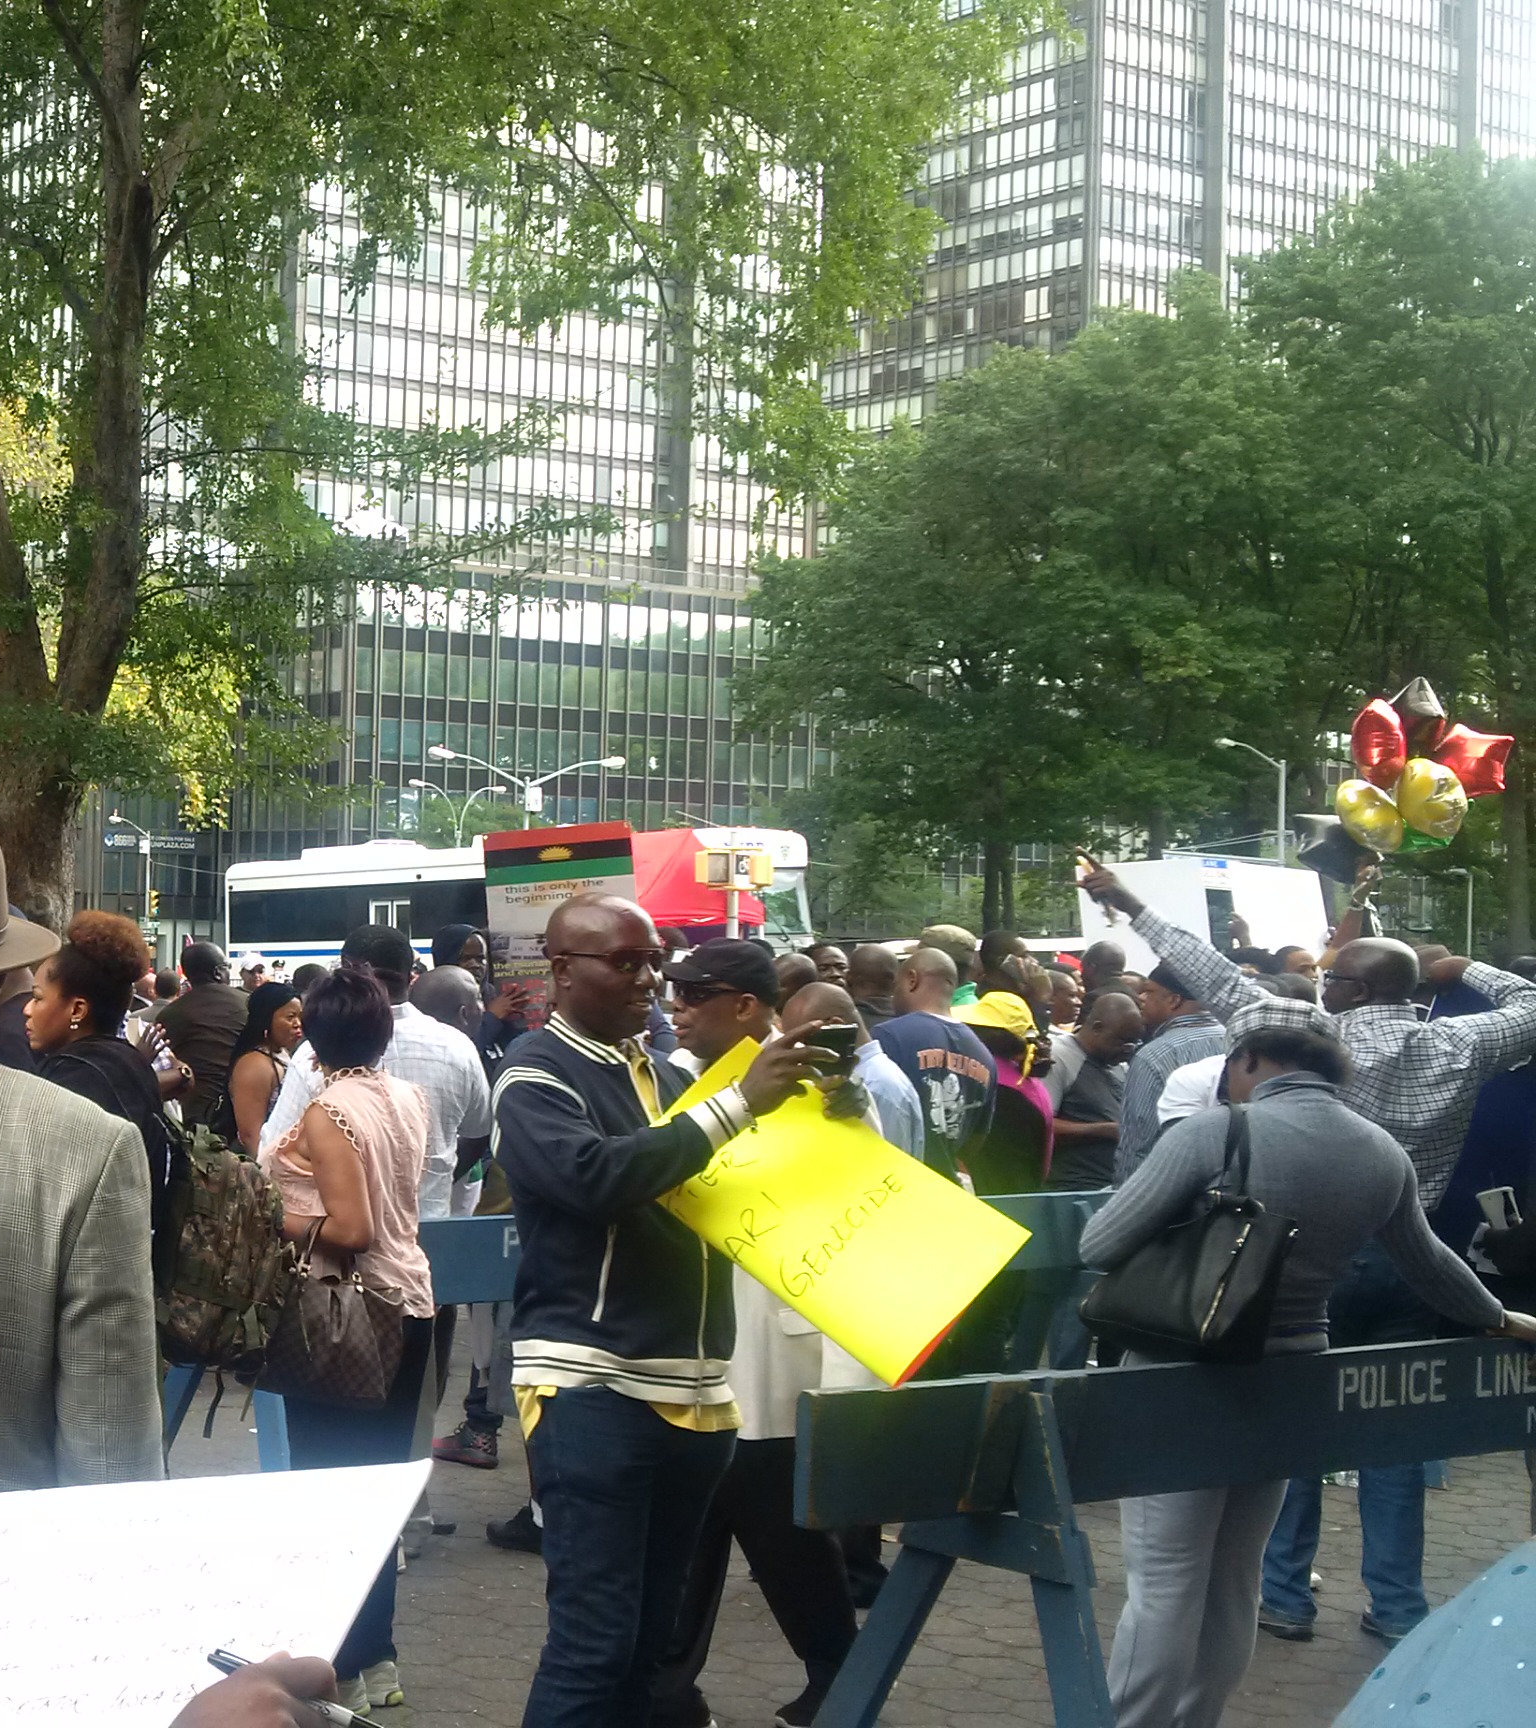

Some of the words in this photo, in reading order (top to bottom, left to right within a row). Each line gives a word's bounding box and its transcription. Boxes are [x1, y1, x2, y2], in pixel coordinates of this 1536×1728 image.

[505, 886, 529, 895] this
[534, 884, 545, 892] is
[549, 880, 578, 891] only
[582, 878, 604, 887] the
[505, 891, 573, 904] beginning
[1337, 1359, 1447, 1412] POLICE
